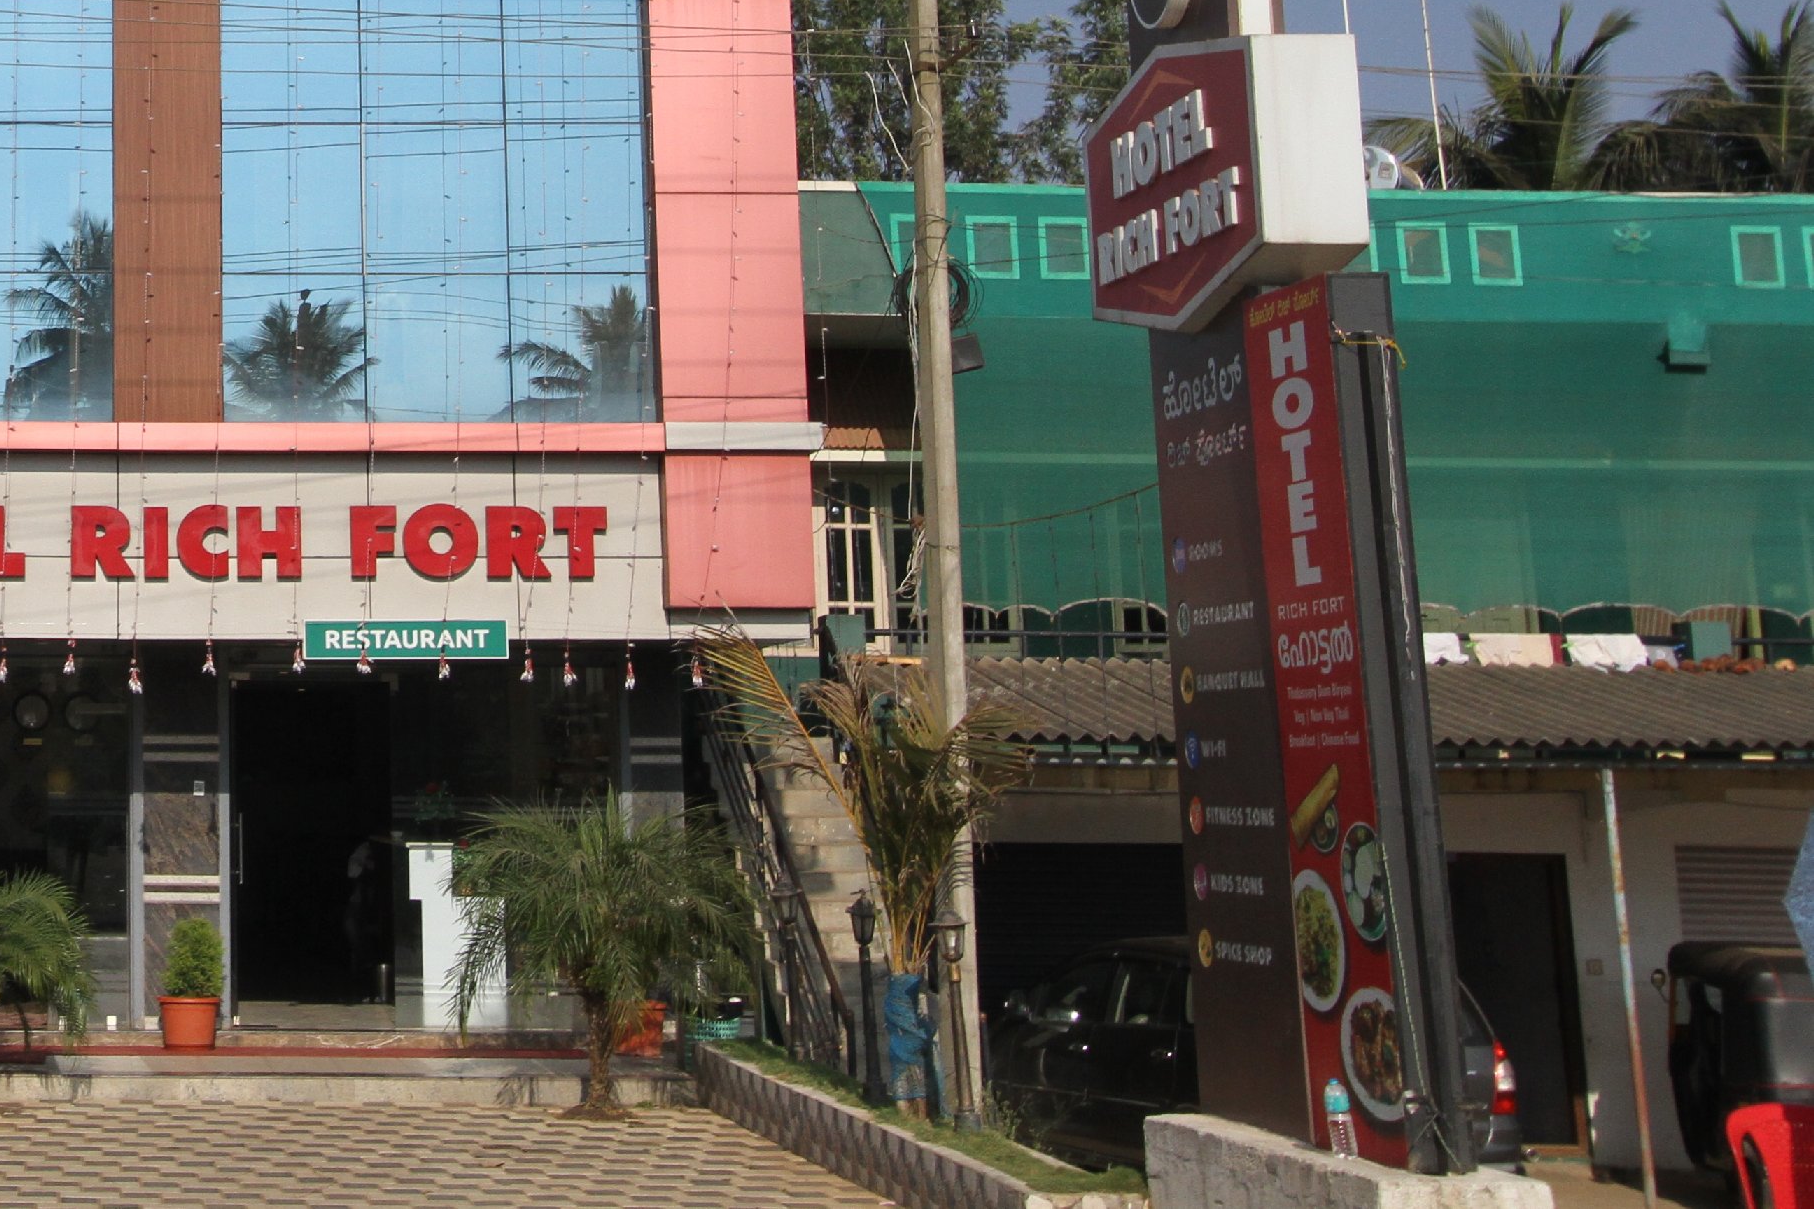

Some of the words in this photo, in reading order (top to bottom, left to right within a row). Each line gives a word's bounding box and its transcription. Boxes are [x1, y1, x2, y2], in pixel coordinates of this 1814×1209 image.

[1110, 89, 1213, 199] HOTEL
[1098, 208, 1160, 287] RICH
[1163, 166, 1240, 255] FORT
[1163, 353, 1242, 420] ಹೋಟೆಲ್
[1268, 320, 1322, 587] HOTEL
[70, 504, 302, 581] RICH
[350, 503, 607, 581] FORT
[1193, 601, 1254, 626] RESTAURANT
[1277, 602, 1308, 620] RICH
[1312, 596, 1345, 616] FORT
[324, 628, 489, 651] RESTAURANT
[1196, 671, 1238, 691] BANQUET
[1240, 670, 1265, 688] HALL
[1206, 806, 1244, 826] FITNESS
[1246, 806, 1275, 826] ZONE
[1210, 873, 1235, 893] KIDS
[1235, 875, 1264, 896] ZONE
[1215, 941, 1242, 962] SPICE
[1244, 945, 1272, 967] SHOP
